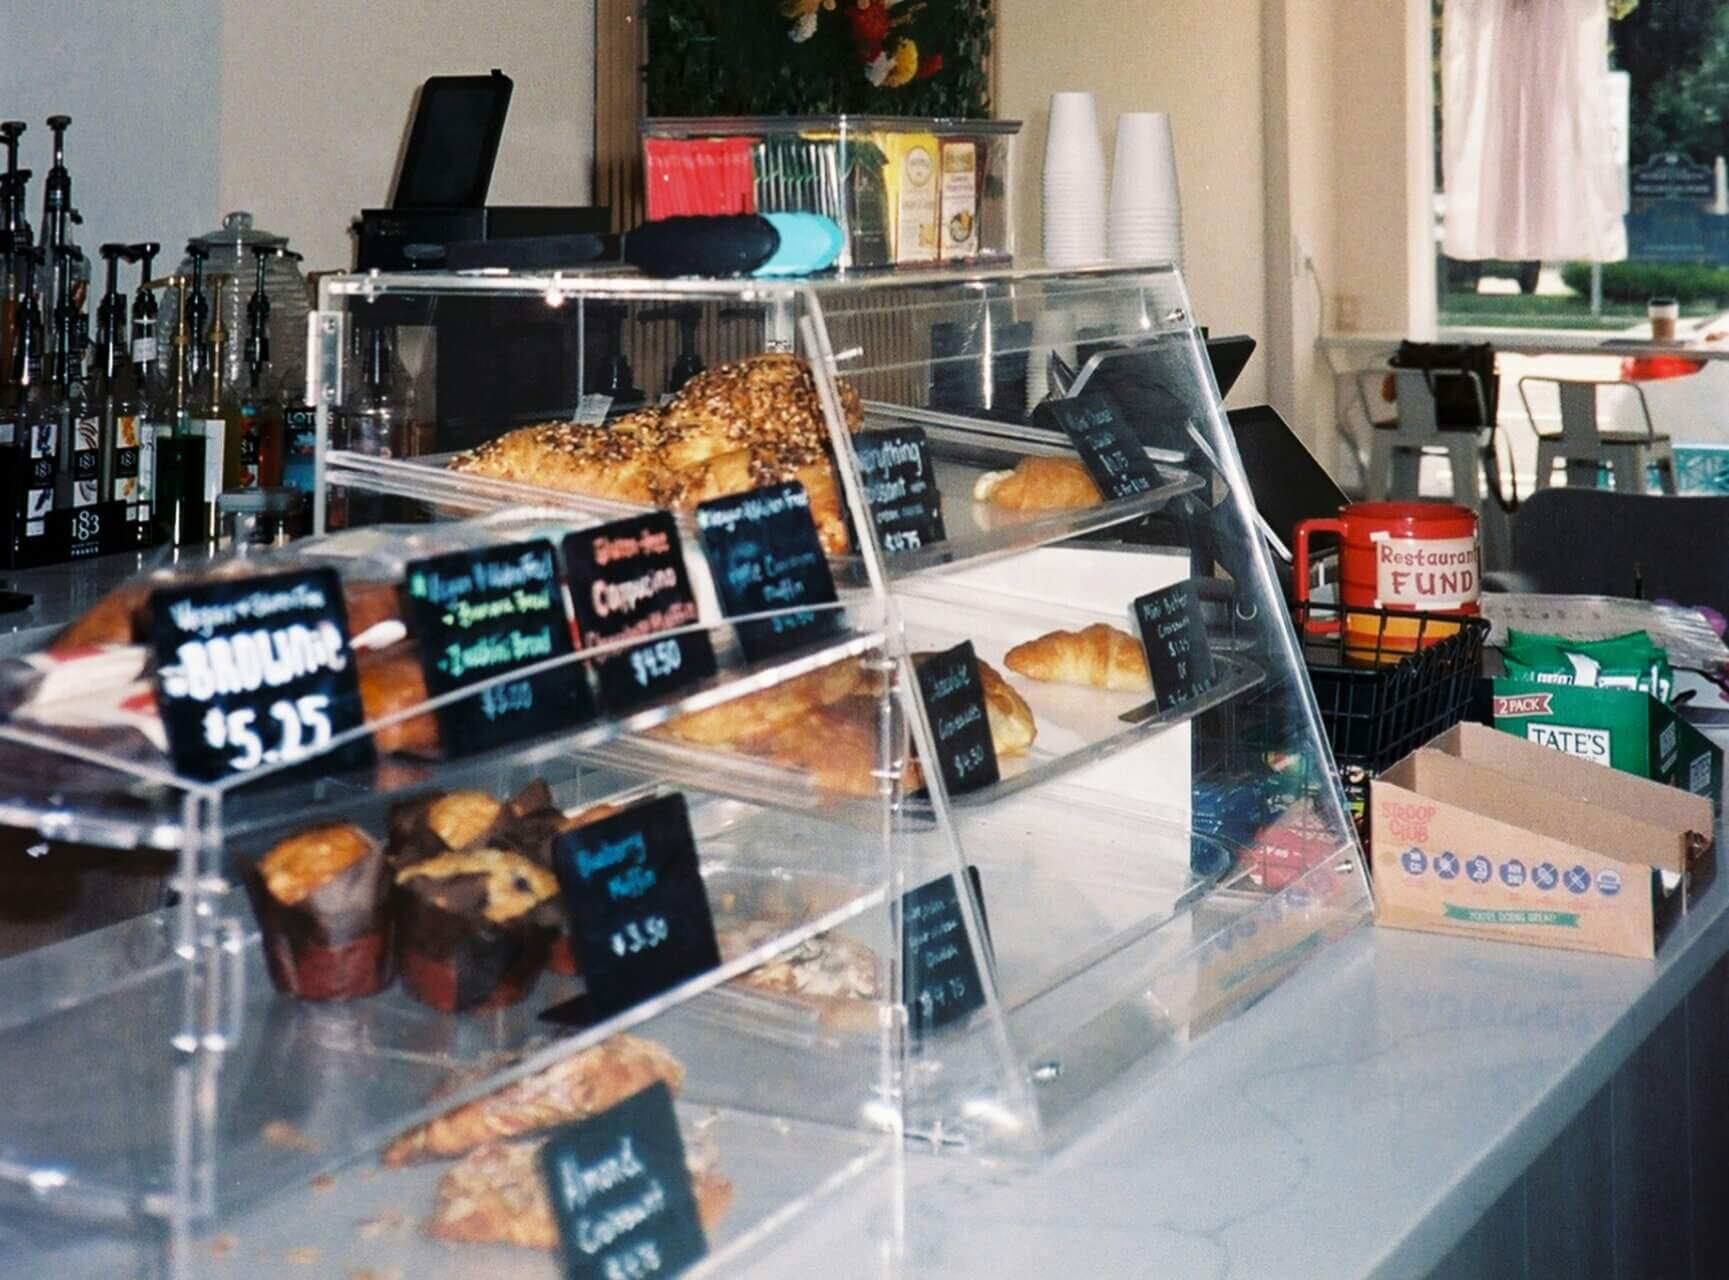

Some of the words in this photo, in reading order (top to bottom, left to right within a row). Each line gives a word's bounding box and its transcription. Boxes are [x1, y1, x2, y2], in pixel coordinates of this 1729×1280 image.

[287, 410, 334, 425] LOTS
[71, 510, 100, 541] 1883
[1391, 570, 1473, 596] FUND
[1499, 699, 1509, 715] 2
[1510, 697, 1541, 713] PACK
[202, 693, 333, 770] $5.25
[1532, 728, 1606, 756] TATE'S
[1390, 820, 1429, 843] CLUB
